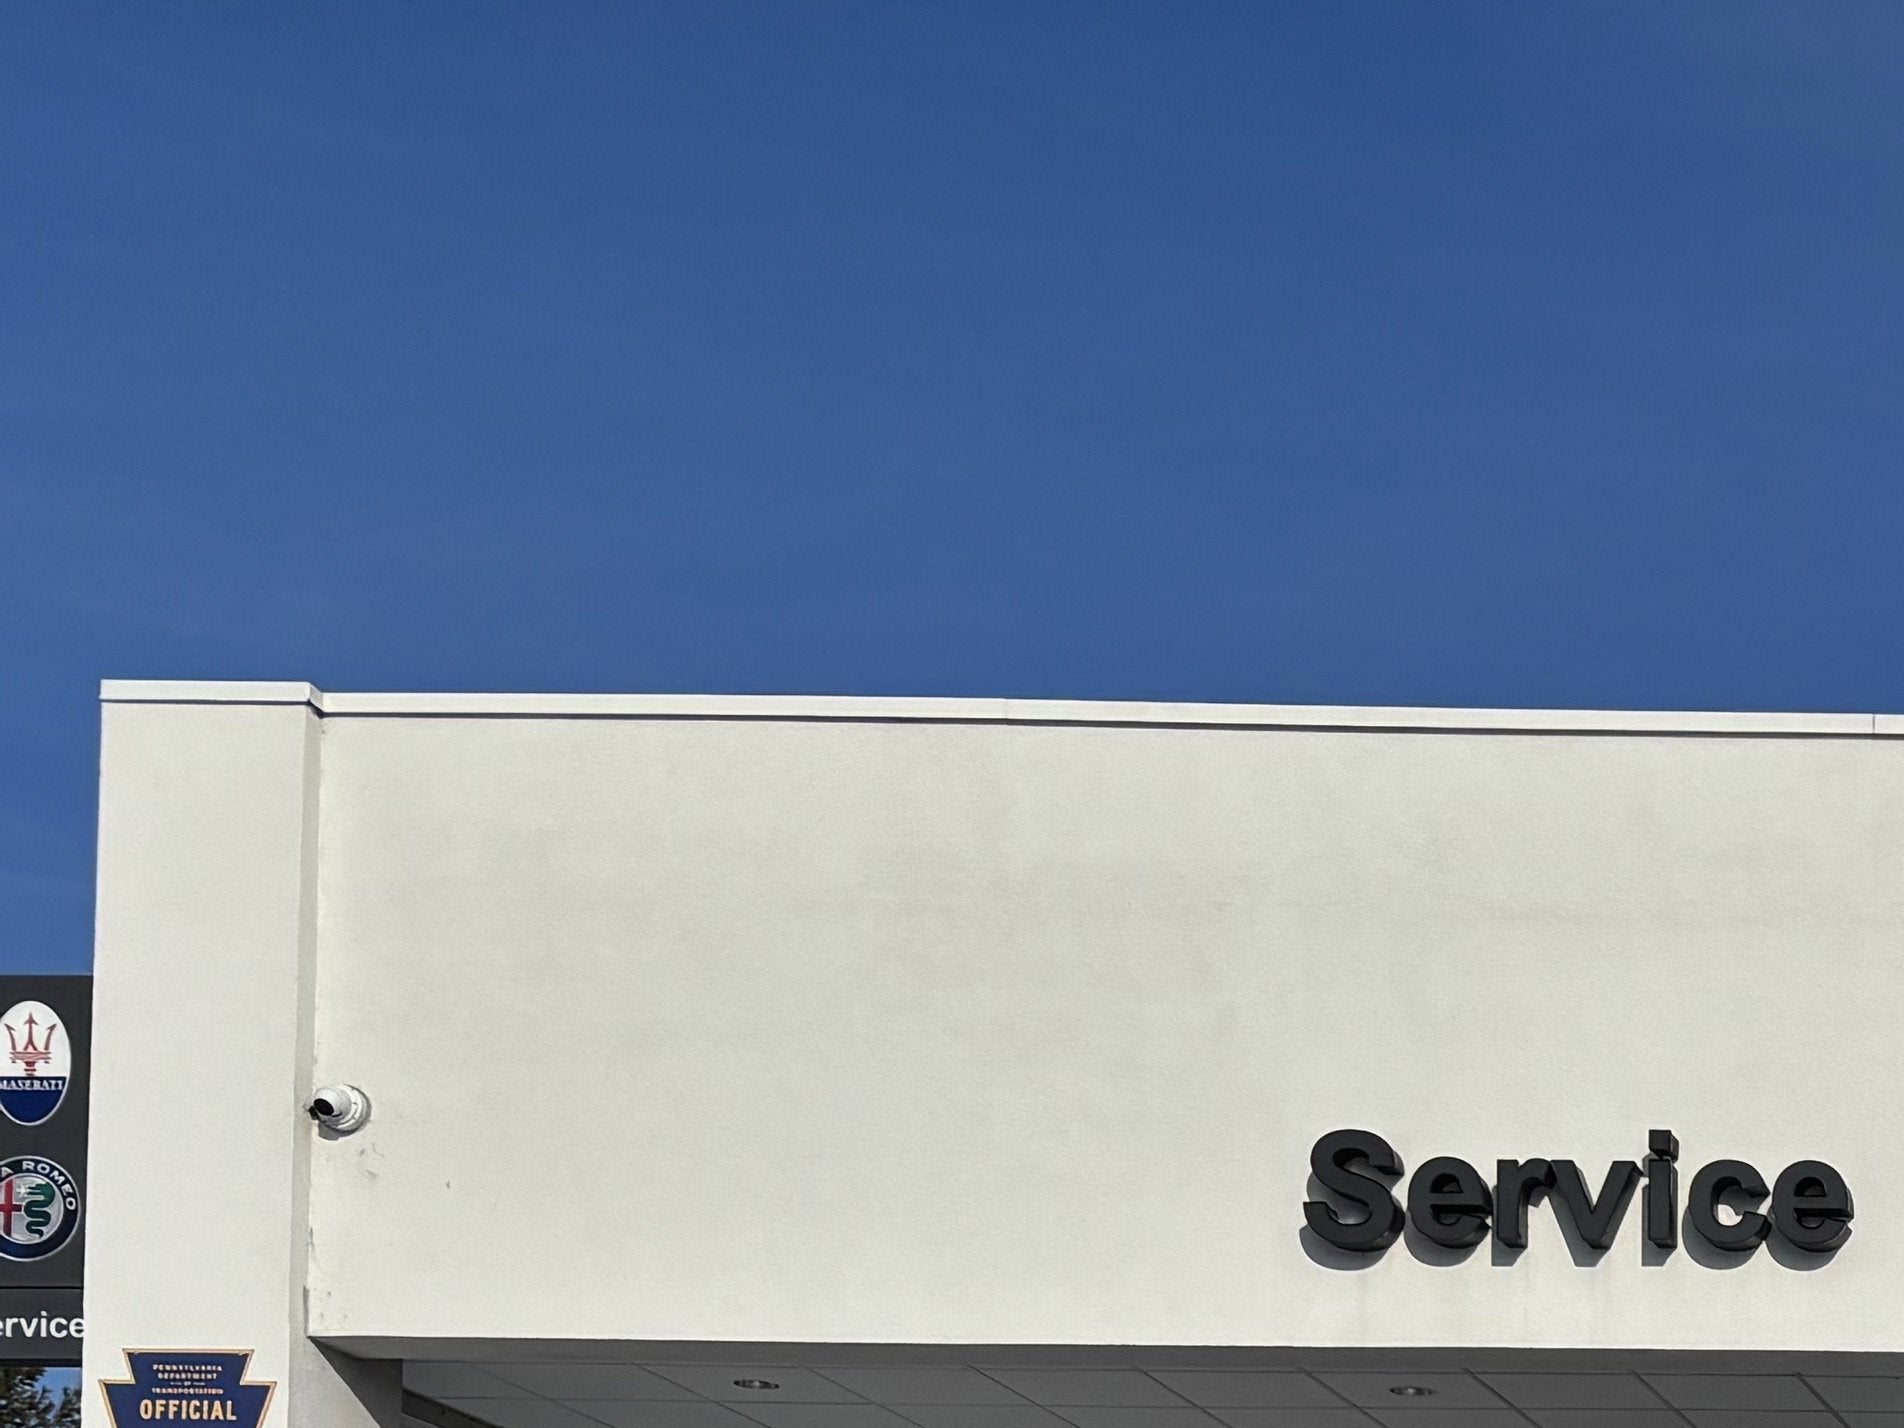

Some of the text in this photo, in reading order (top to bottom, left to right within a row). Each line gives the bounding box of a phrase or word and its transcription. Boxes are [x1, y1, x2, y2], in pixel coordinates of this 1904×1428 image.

[22, 1160, 77, 1211] ROMEO
[1302, 1128, 1855, 1262] Service
[0, 1311, 84, 1339] rvice
[152, 1363, 222, 1372] PENNSYLVANIA
[157, 1372, 218, 1380] DEPARTMENT
[151, 1386, 225, 1395] TRANSPORTATION
[139, 1398, 238, 1421] OFFICIAL
